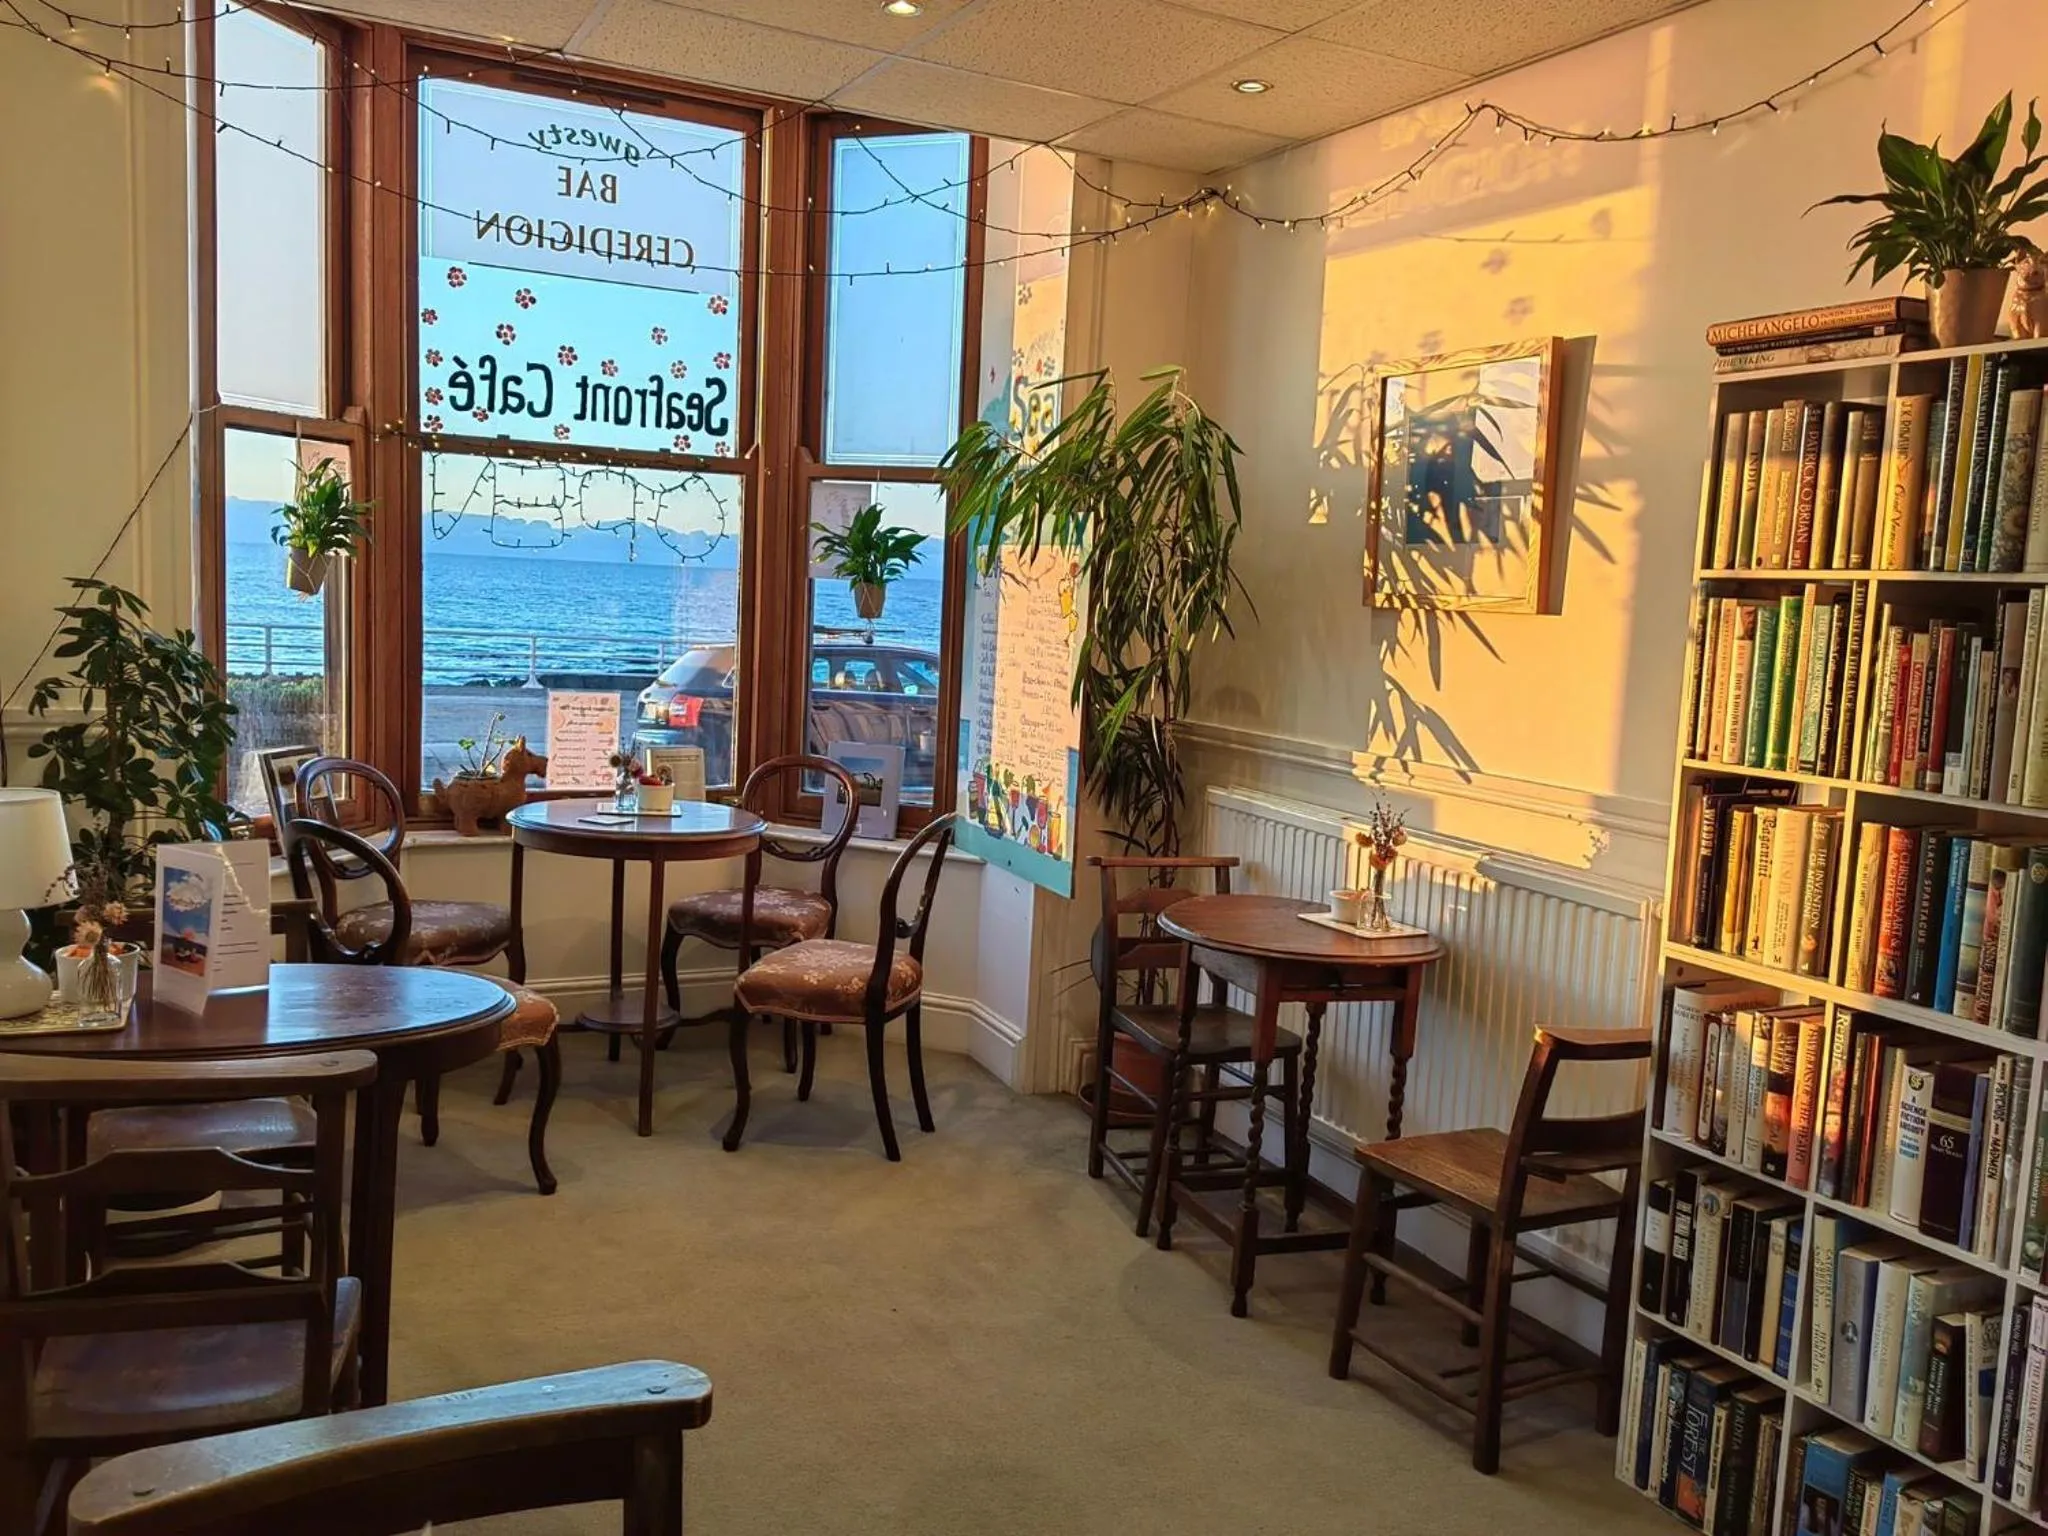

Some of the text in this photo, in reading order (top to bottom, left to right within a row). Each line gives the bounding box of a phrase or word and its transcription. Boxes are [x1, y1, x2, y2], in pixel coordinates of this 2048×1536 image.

[1711, 314, 1820, 342] MICHELANGELO
[1746, 451, 1759, 493] INDIA
[1802, 429, 1819, 484] PATRICK
[1856, 585, 1866, 606] THE
[1851, 636, 1861, 651] OF
[1852, 613, 1863, 634] ART
[1848, 656, 1858, 679] THE
[1926, 670, 1934, 683] Why
[1701, 807, 1716, 857] WISDEN
[1811, 847, 1827, 928] THE INVENTION
[1883, 851, 1899, 937] ARCHITECTURE
[1894, 852, 1911, 912] CHRISTIAN
[1917, 836, 1937, 944] BLACK SPARTACUS
[1892, 914, 1904, 937] ART
[1983, 939, 1998, 968] ANNE
[1769, 1032, 1785, 1074] SMITH
[1832, 1011, 1850, 1066] Renoir
[1799, 1101, 1812, 1124] THE
[1900, 1111, 1926, 1126] FICTION
[1993, 1081, 2009, 1122] PSYCHOS
[1795, 1125, 1810, 1165] HEART
[1940, 1134, 1955, 1149] 65
[1987, 1137, 2002, 1180] MADMEN
[2031, 1360, 2042, 1380] THE
[1680, 1402, 1709, 1478] FOREST
